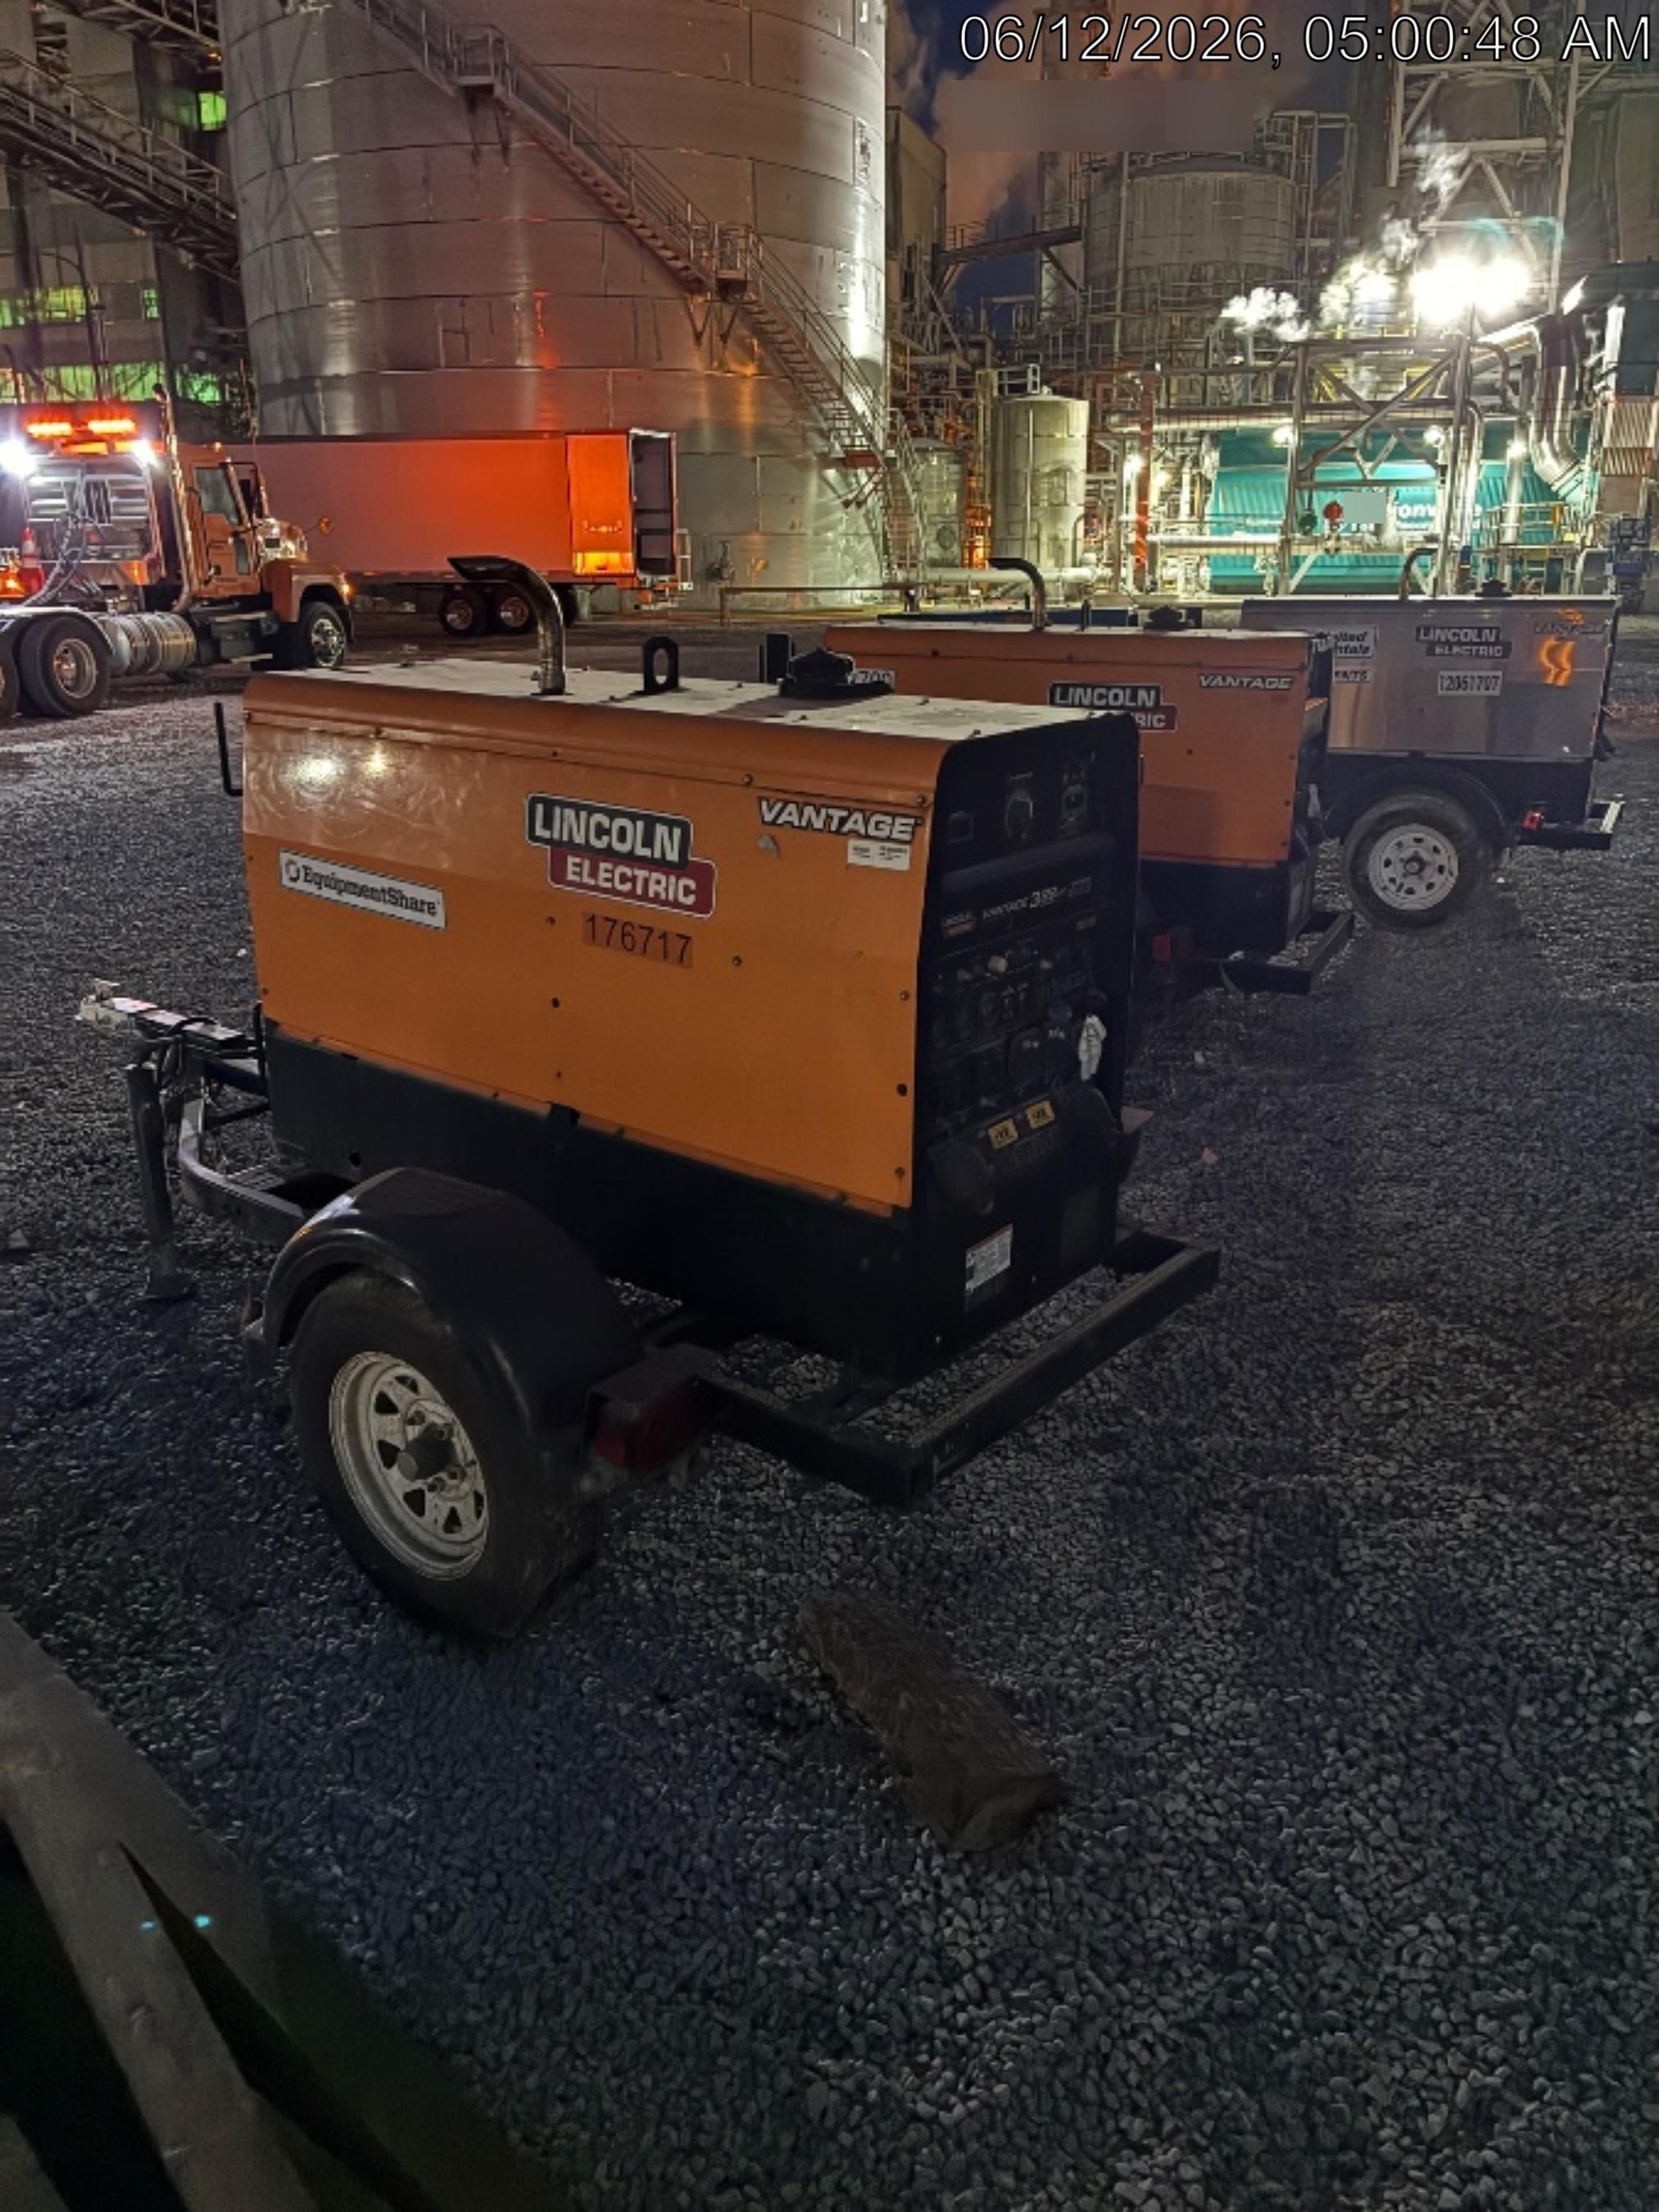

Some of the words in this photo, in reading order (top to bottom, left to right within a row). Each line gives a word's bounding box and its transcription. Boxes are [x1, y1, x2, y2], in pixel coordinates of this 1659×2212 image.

[1420, 628, 1496, 642] LINCOLN
[1054, 686, 1157, 708] LINCOLN
[1199, 675, 1292, 690] VANTAGE
[534, 802, 682, 863] LINCOLN
[759, 798, 917, 842] VANTAGE
[301, 863, 438, 917] EquipmentShare
[565, 854, 696, 905] ELECTRIC
[586, 912, 692, 964] 176717
